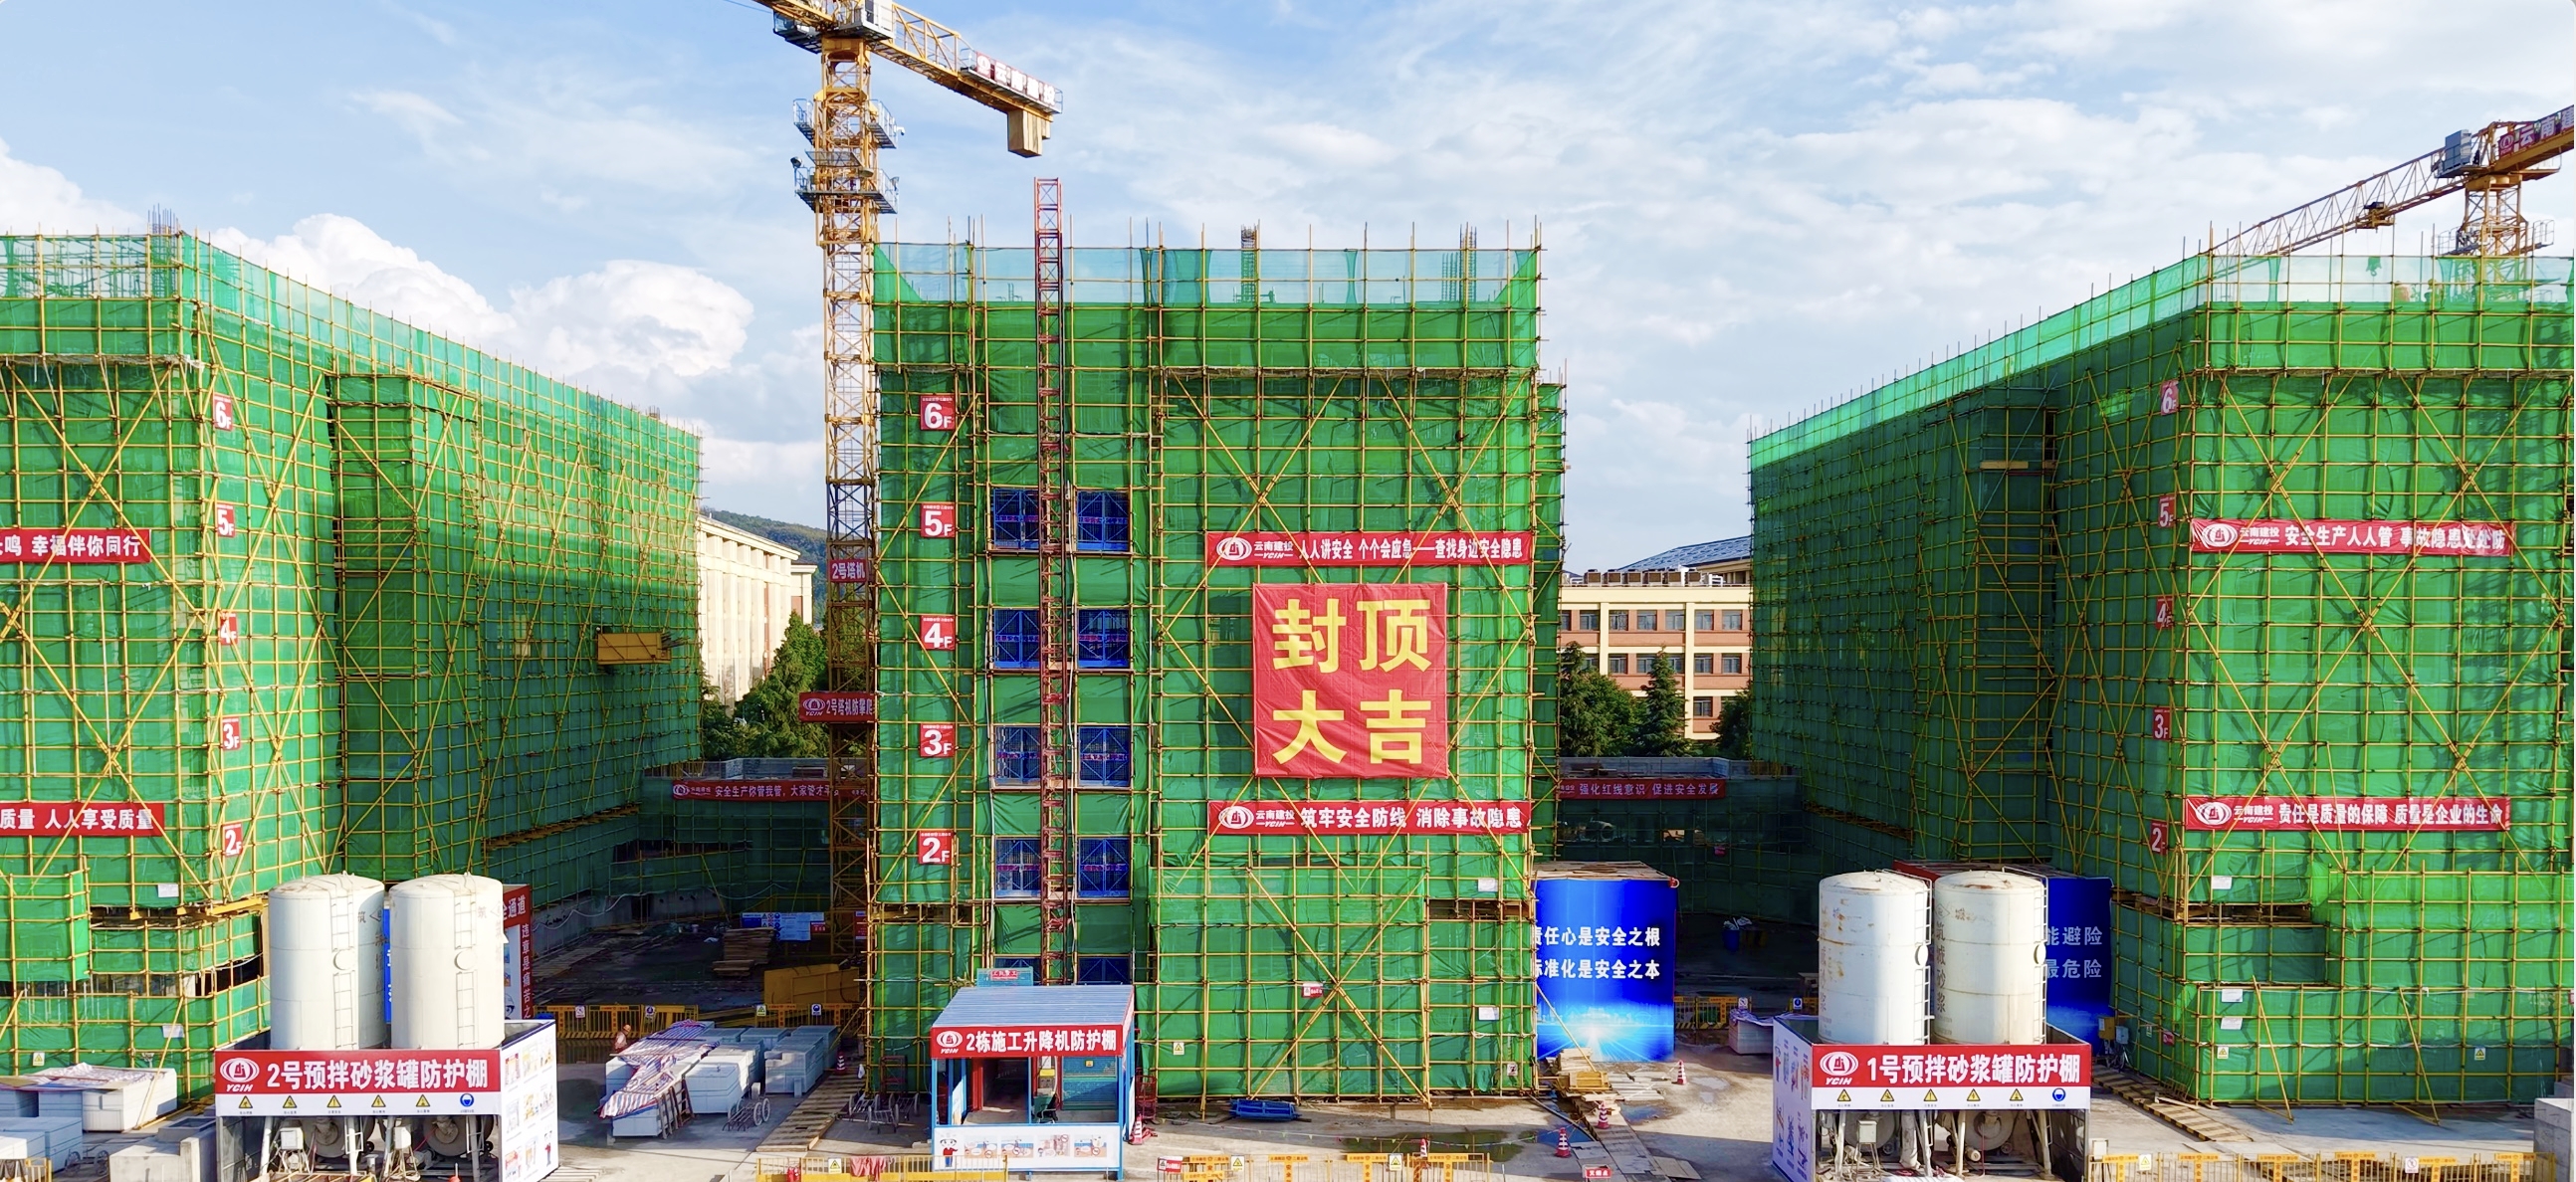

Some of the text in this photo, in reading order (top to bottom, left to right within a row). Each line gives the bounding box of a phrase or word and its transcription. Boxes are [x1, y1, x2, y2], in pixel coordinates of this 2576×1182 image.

[2163, 387, 2177, 414] 6F
[215, 401, 232, 429] 6F
[925, 402, 953, 429] 6F
[217, 509, 235, 536] 5F
[925, 509, 953, 536] 5F
[2159, 502, 2174, 527] 5F
[2240, 527, 2280, 537] 云南建投
[2284, 524, 2505, 549] 安全生产人人管 事故隐患处处防
[0, 534, 141, 557] 鸣 幸福伴你同行
[1253, 541, 1294, 551] 云南建投
[1299, 538, 1353, 559] 人人讲安全
[831, 561, 866, 579] 2号塔机
[220, 619, 237, 645] 4F
[924, 622, 954, 649] 4F
[1272, 598, 1432, 674] 封顶
[222, 723, 240, 750] 3F
[1272, 689, 1431, 764] 大吉
[2154, 713, 2169, 739] 3F
[924, 728, 953, 755] 3F
[1580, 783, 1645, 795] 强化红线意识
[1652, 783, 1719, 795] 促进安全发展
[0, 808, 154, 831] 质量 人人享受质量
[1255, 810, 1295, 820] 云南建投
[1301, 807, 1522, 829] 筑牢安全防线 消除事故隐患
[2234, 805, 2273, 816] 云南建投
[2279, 803, 2502, 825] 责任是质量的保障 质量是企业的生命
[225, 829, 243, 856] 2F
[922, 837, 951, 863] 2F
[966, 1029, 1117, 1053] 2栋施工升降机防护棚
[267, 1058, 488, 1090] 2号预拌砂浆罐防护棚
[1825, 1077, 1852, 1085] YCIH
[1867, 1053, 2080, 1084] 1号预拌砂浆罐防护棚
[226, 1084, 254, 1092] YCIH
